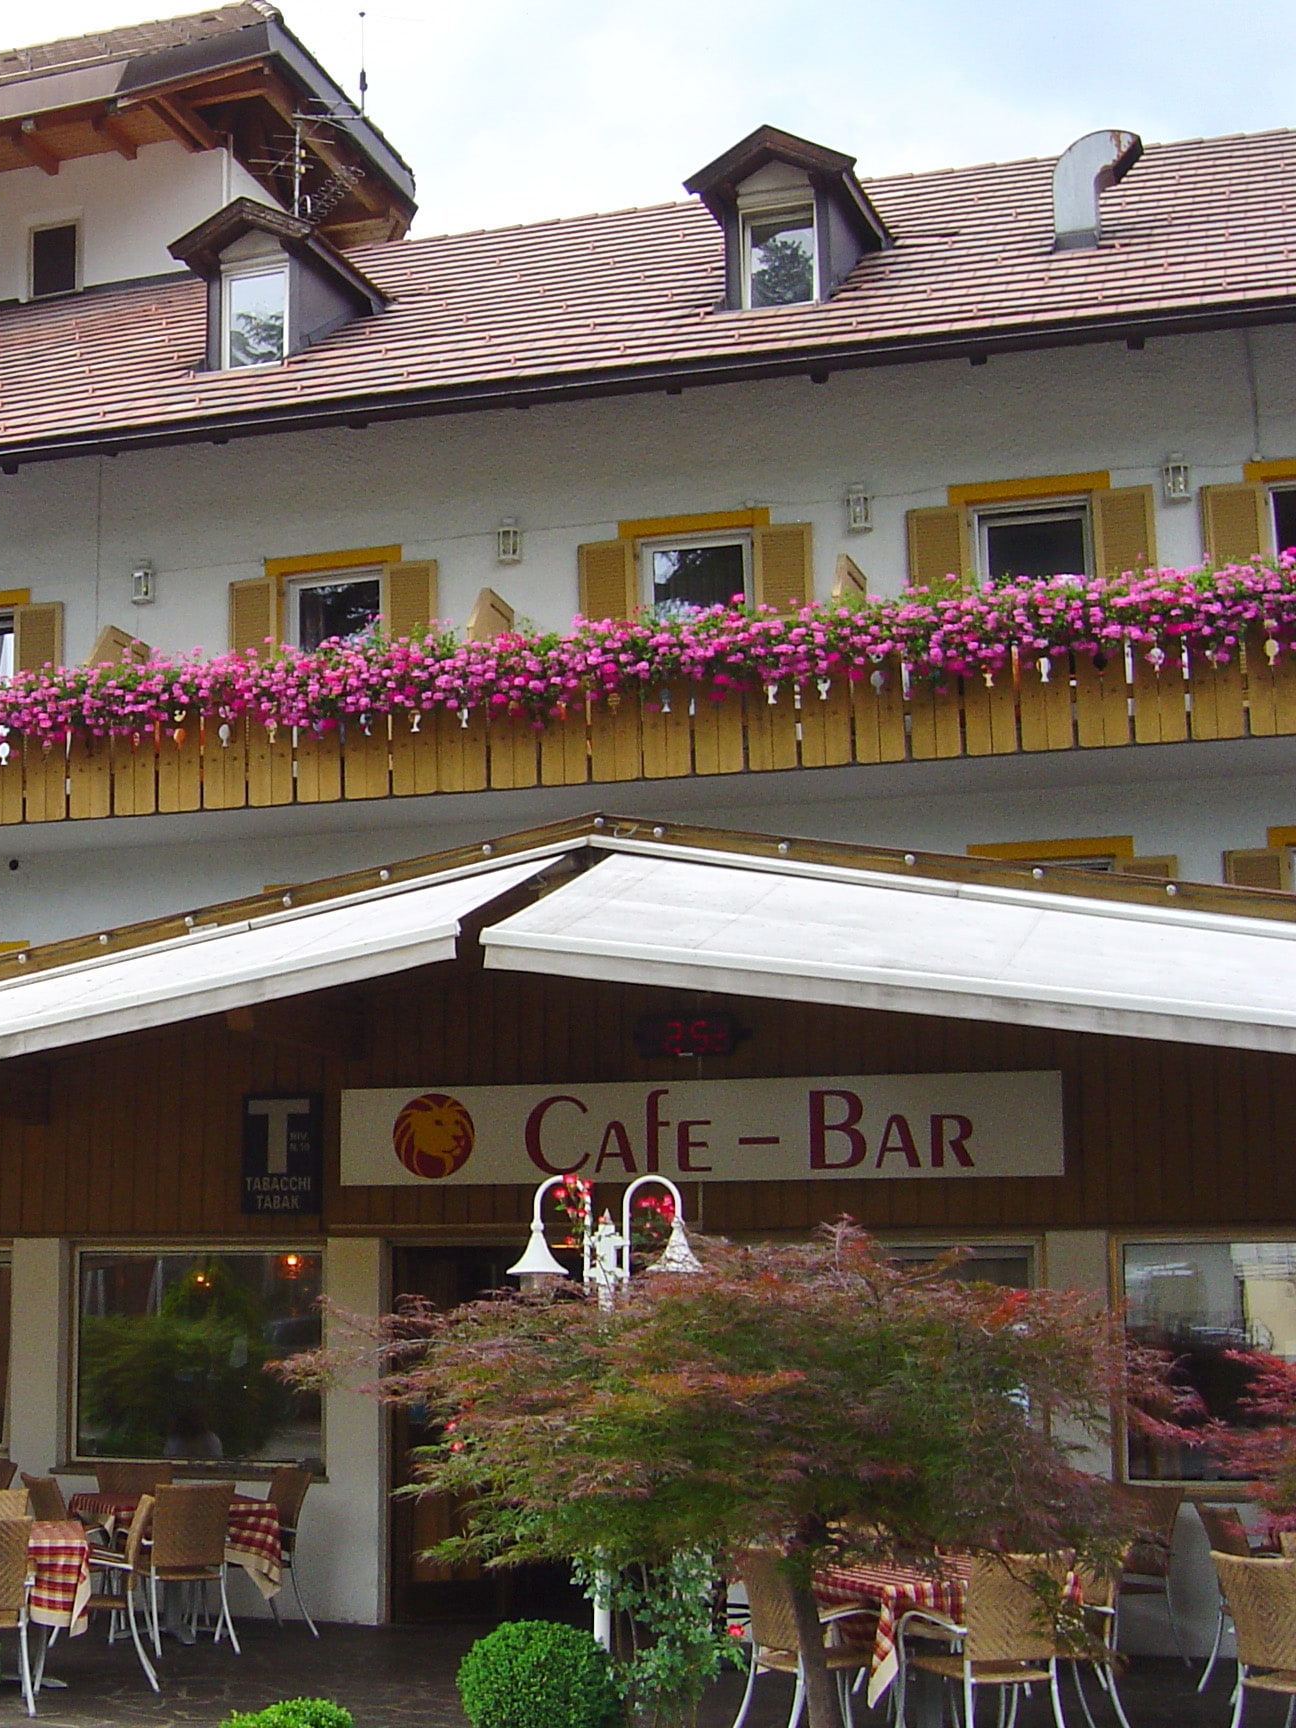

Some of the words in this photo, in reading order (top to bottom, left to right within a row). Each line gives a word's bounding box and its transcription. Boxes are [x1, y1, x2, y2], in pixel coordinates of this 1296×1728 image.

[247, 1098, 310, 1174] T
[808, 1089, 975, 1170] BAR
[246, 1177, 311, 1192] TABACCHI
[256, 1194, 300, 1210] TABAK
